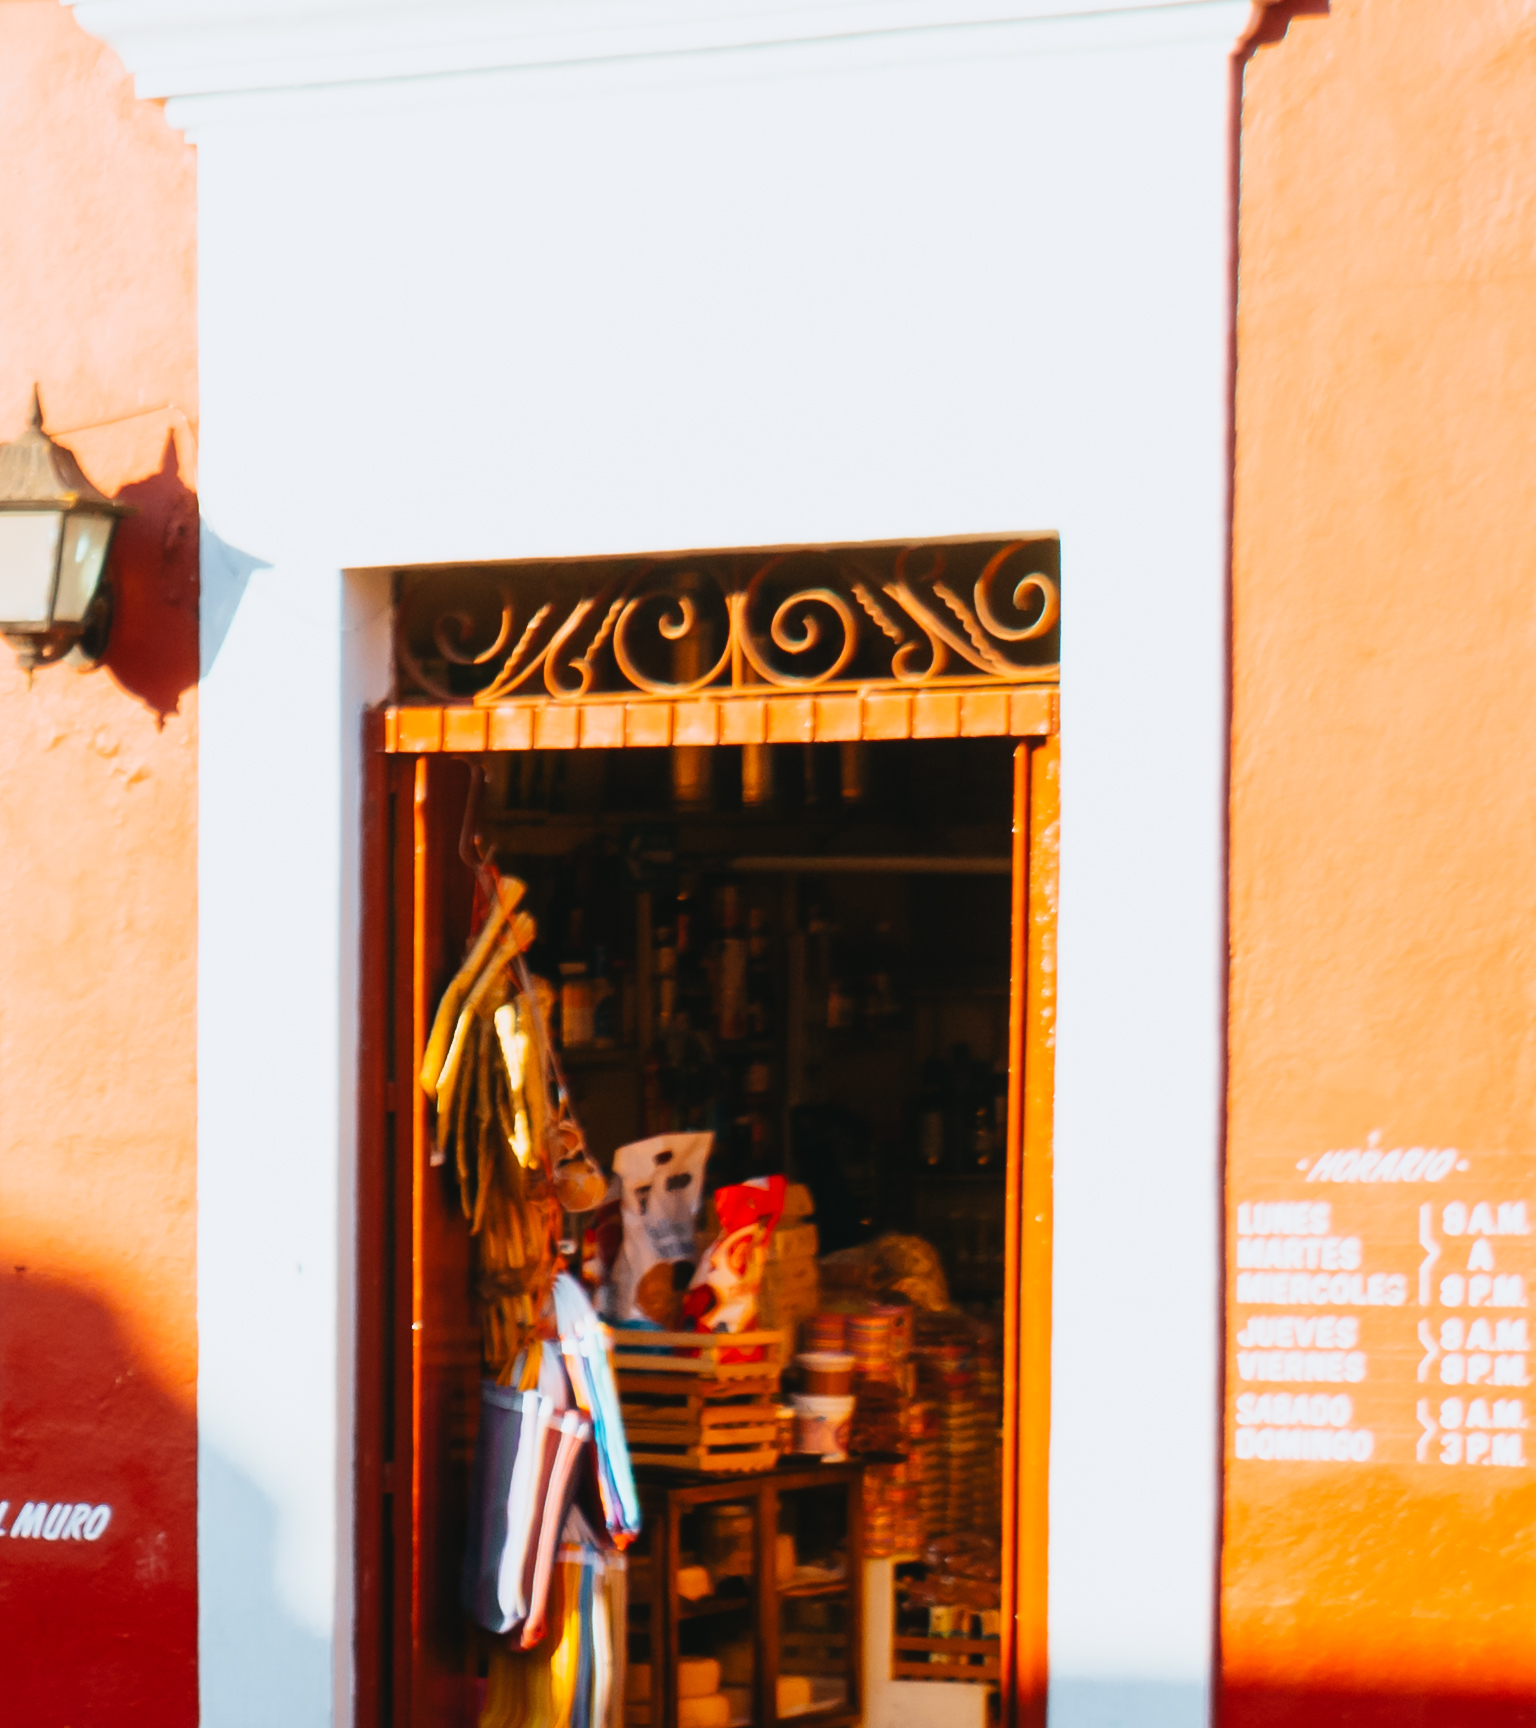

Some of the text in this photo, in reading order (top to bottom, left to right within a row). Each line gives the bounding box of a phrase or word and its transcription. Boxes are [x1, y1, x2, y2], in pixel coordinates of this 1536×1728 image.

[1305, 1146, 1459, 1183] HORARIO
[1236, 1200, 1332, 1237] LUNES
[1236, 1235, 1495, 1272] MARTES A
[1236, 1271, 1408, 1307] MIERCOLES
[1236, 1315, 1360, 1349] JUEVES
[1236, 1349, 1368, 1383] VIERNES
[1235, 1392, 1354, 1427] SABADO
[1234, 1427, 1375, 1463] DOMINGO
[9, 1501, 113, 1541] MURO
